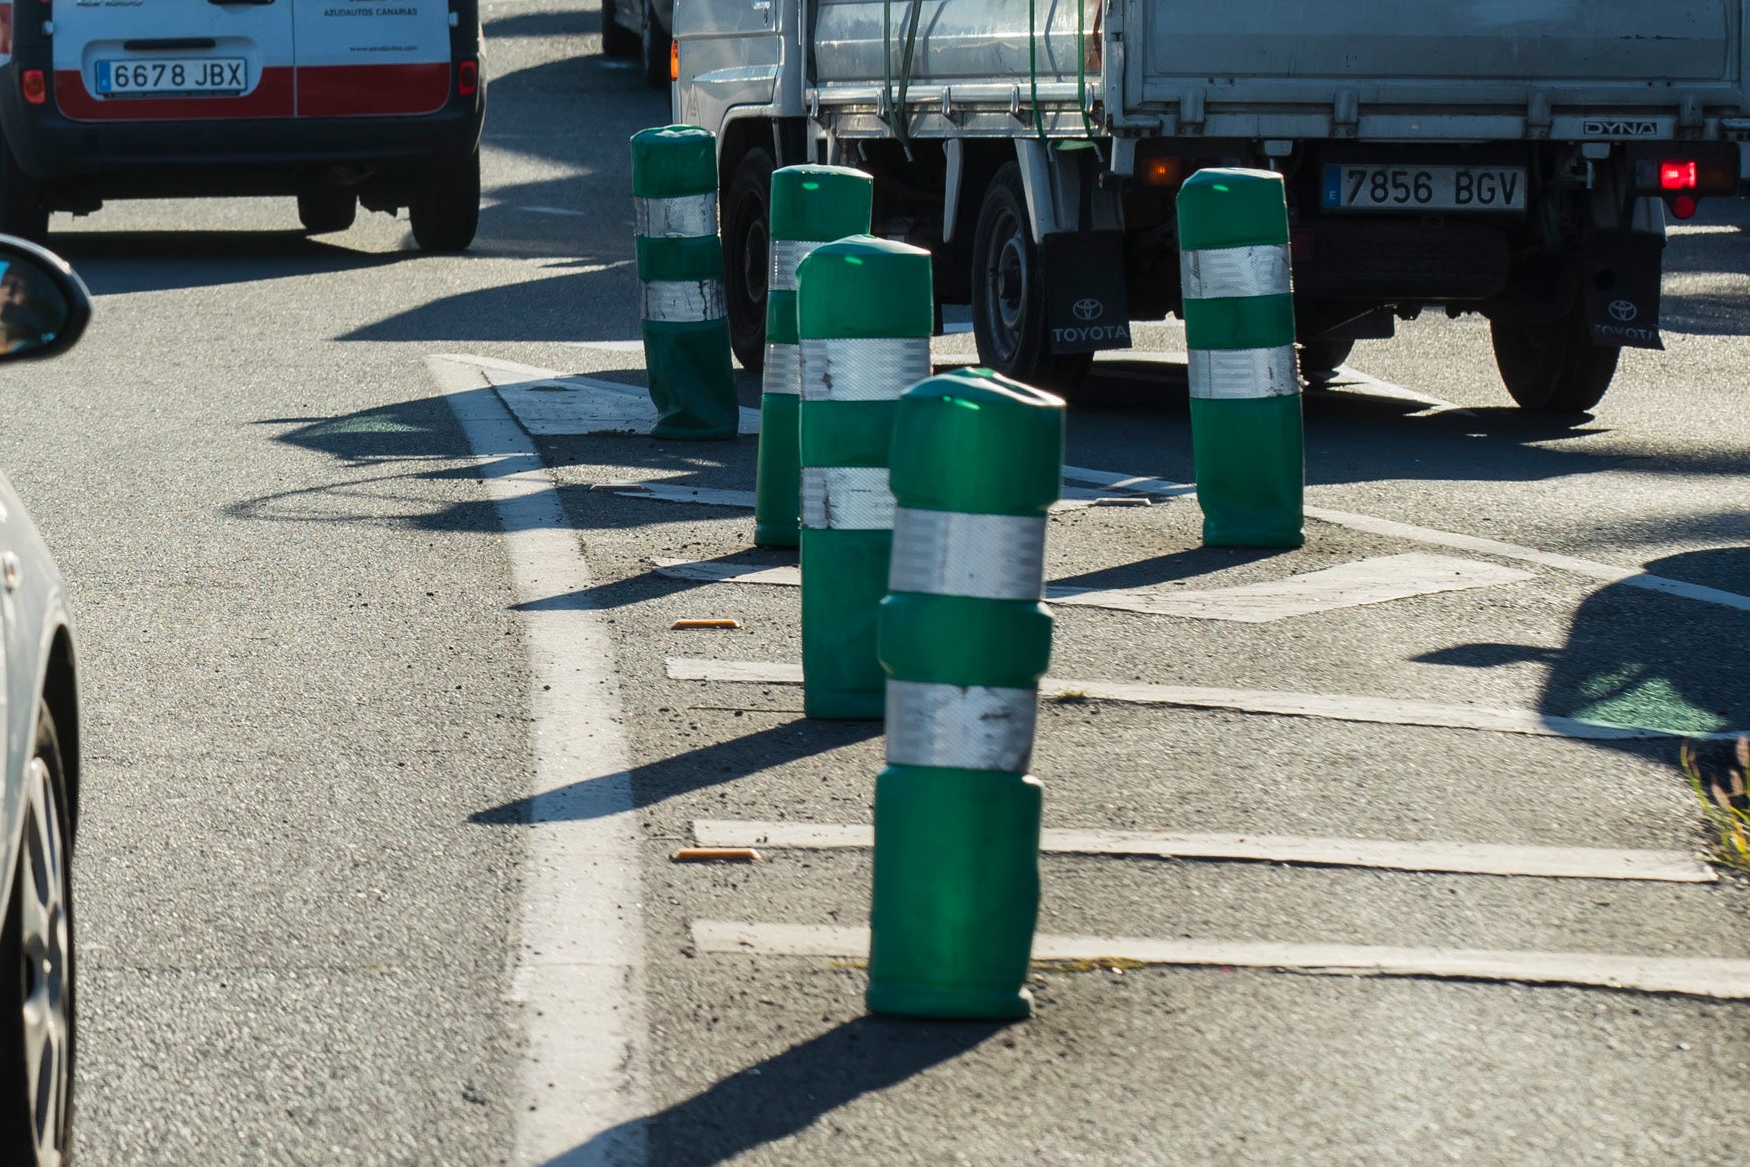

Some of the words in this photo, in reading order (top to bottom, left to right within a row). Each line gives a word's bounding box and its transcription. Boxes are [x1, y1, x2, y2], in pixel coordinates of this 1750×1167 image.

[114, 64, 186, 88] 6678
[194, 63, 241, 86] JBX
[1584, 121, 1657, 135] DYNA
[1347, 170, 1433, 205] 7856
[1453, 170, 1518, 206] BGV
[1052, 325, 1129, 342] TOYOTA
